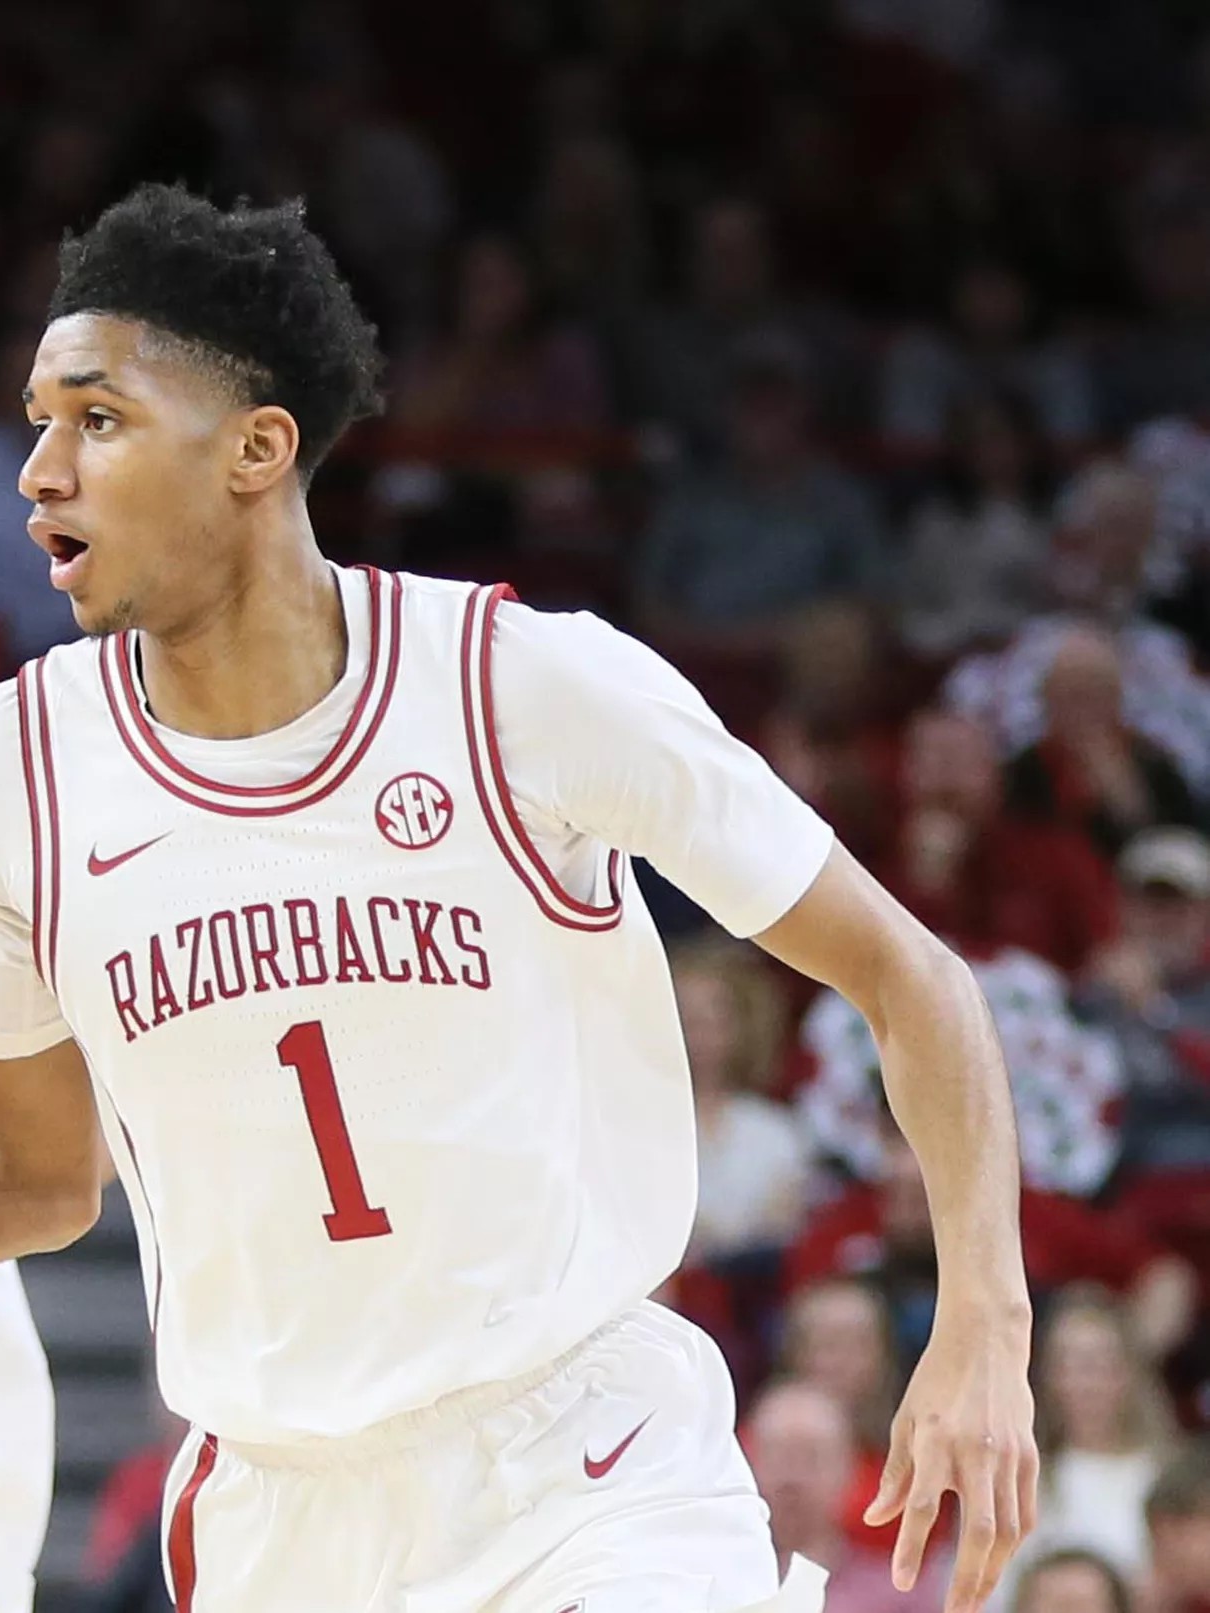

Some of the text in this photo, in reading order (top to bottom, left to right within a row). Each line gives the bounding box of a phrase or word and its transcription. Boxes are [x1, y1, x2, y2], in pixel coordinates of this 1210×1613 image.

[378, 776, 450, 846] SEC
[104, 896, 492, 1043] RAZORBACKS
[276, 1020, 393, 1242] 1
